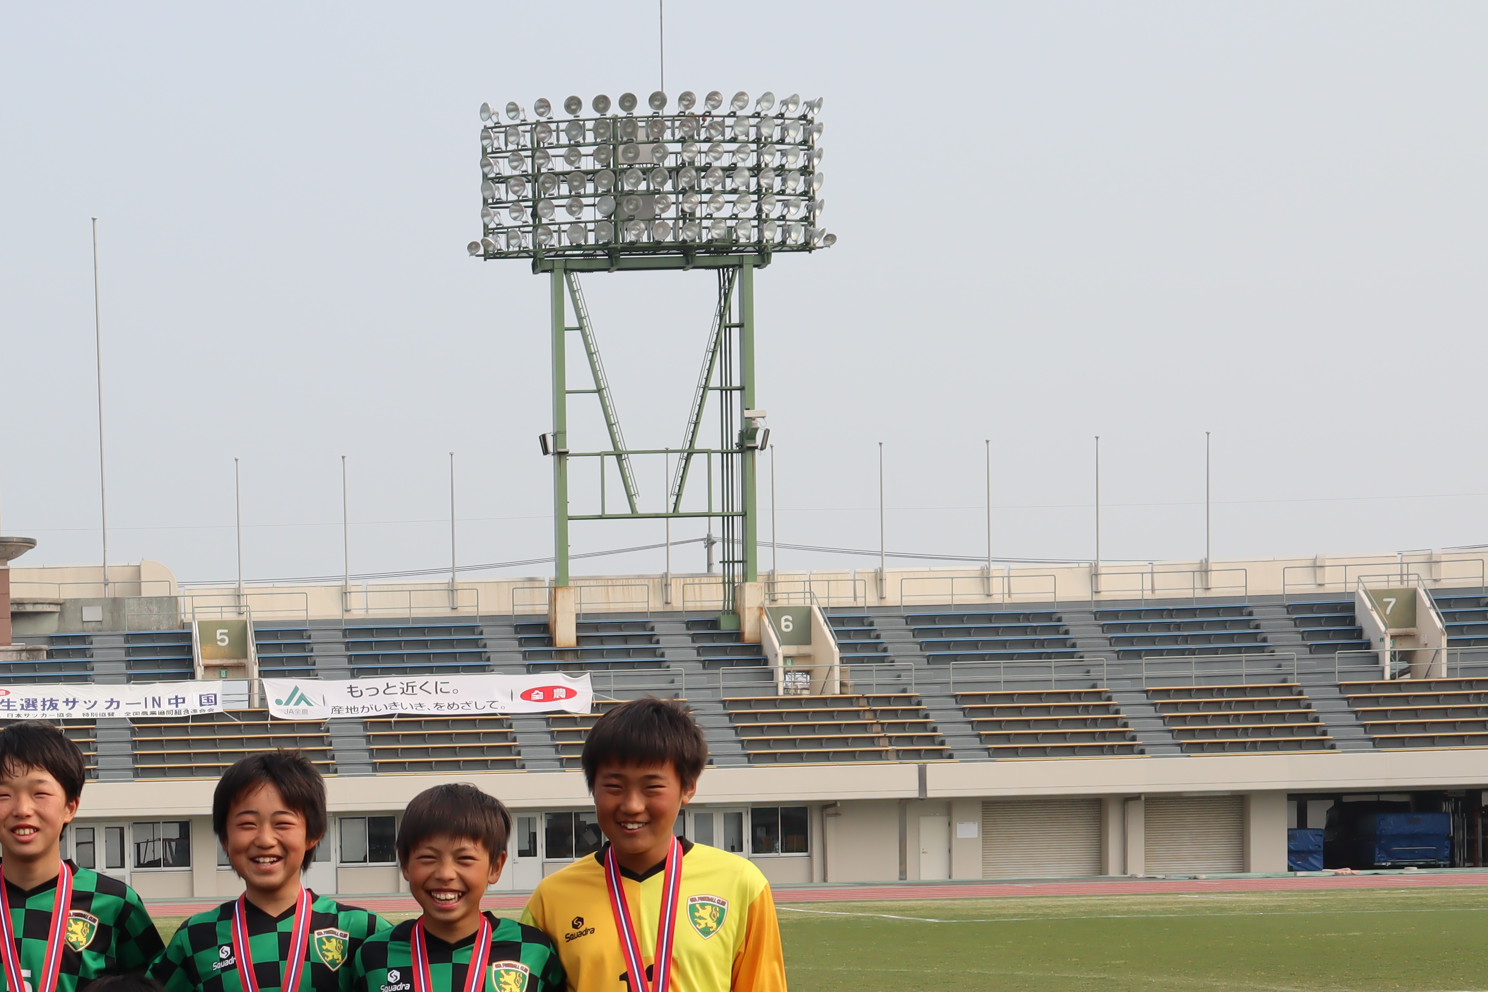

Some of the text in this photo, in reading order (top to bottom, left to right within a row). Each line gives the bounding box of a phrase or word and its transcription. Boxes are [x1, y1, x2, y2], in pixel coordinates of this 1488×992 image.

[1383, 598, 1397, 615] 7
[780, 615, 793, 632] 6
[216, 629, 229, 647] 5
[347, 680, 461, 698] もっと近くに。
[330, 700, 506, 715] 産地がいきいき、をめざして。
[564, 927, 596, 943] Squadra
[212, 956, 236, 971] Squadr
